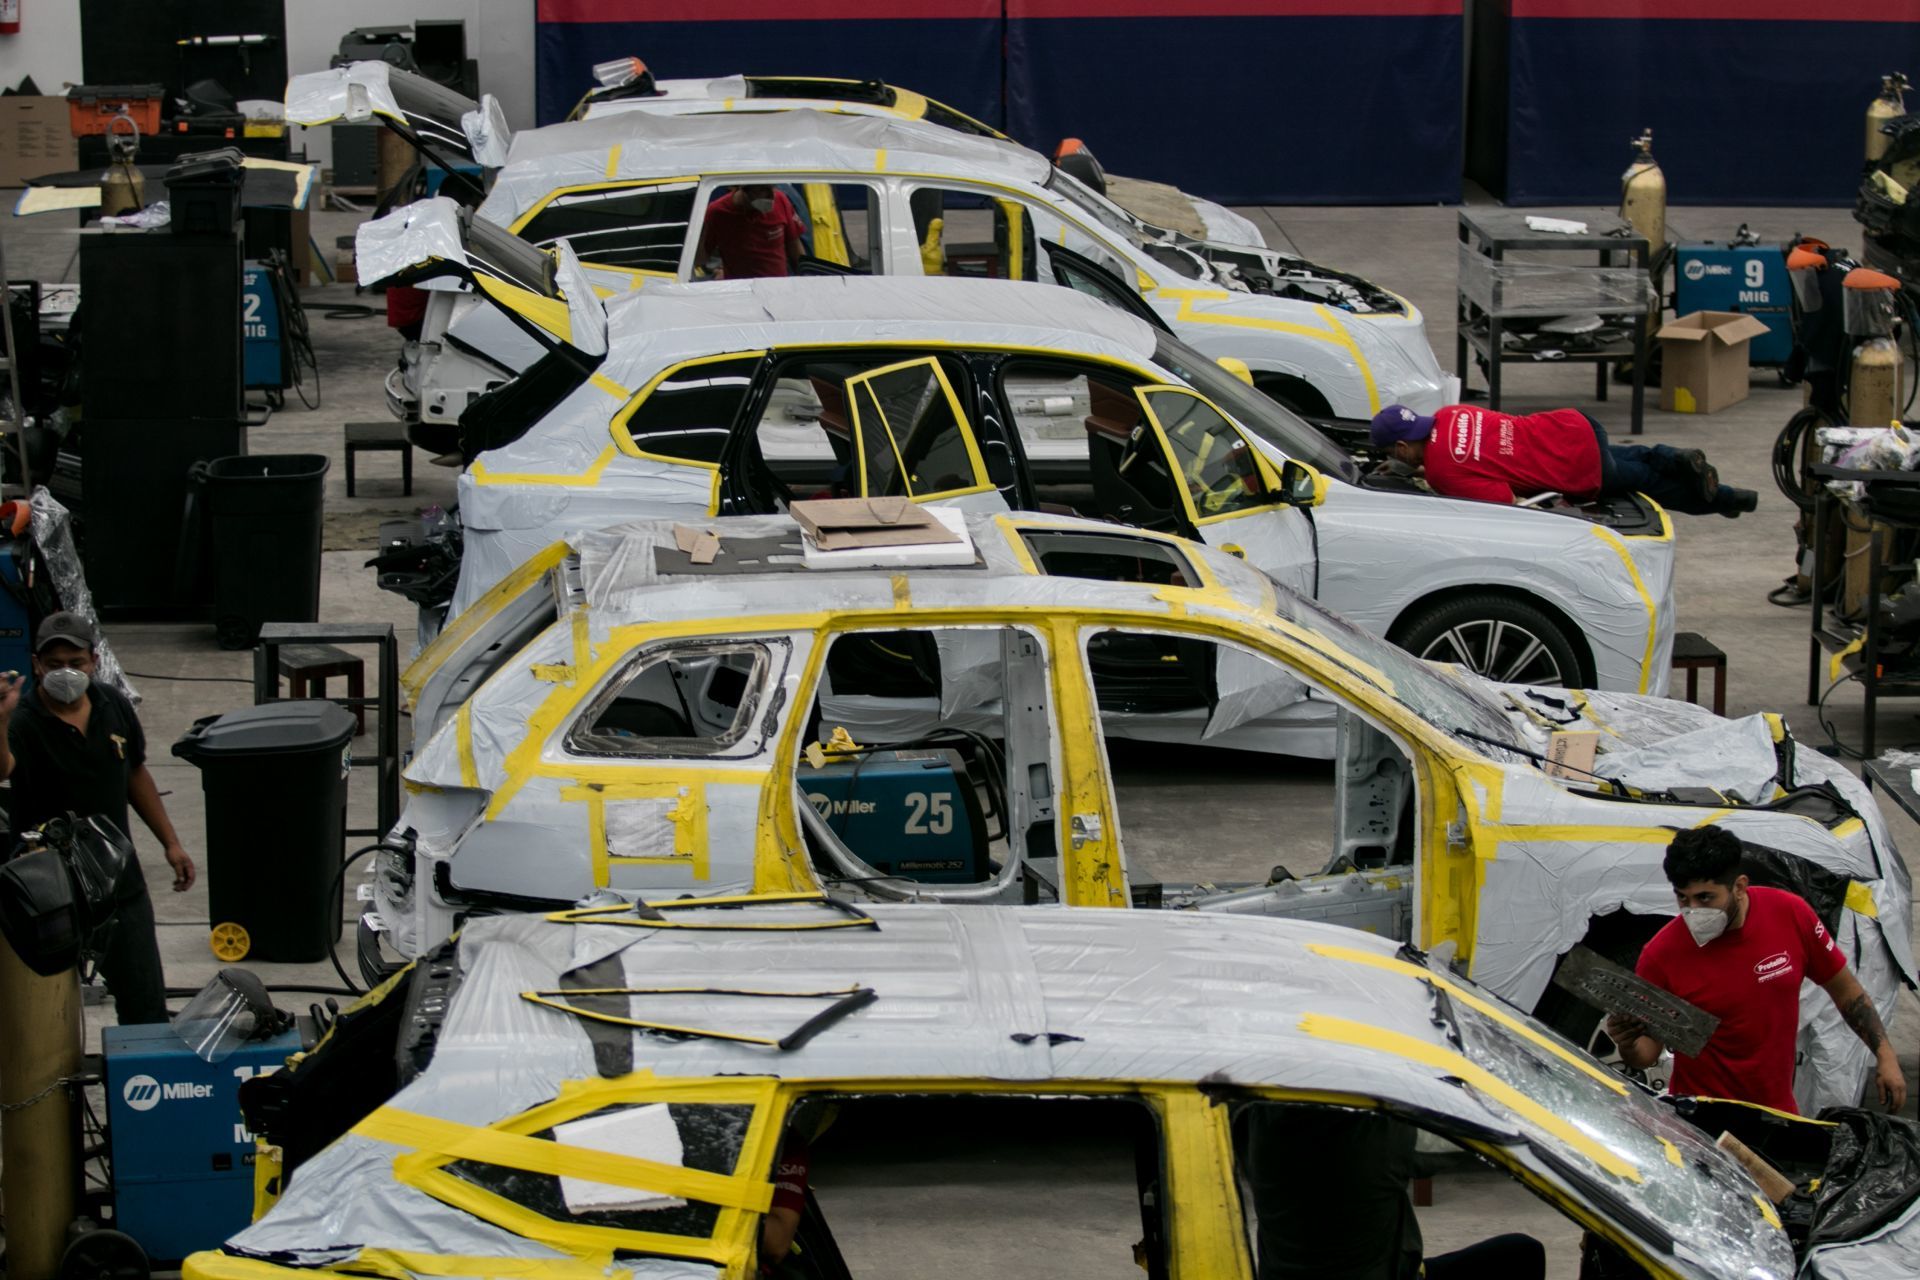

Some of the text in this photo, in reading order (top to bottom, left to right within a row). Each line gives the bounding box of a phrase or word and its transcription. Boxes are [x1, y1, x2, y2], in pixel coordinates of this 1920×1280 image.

[1744, 259, 1764, 288] 9
[243, 293, 261, 322] 2
[1738, 290, 1769, 303] MIG
[904, 792, 953, 835] 25
